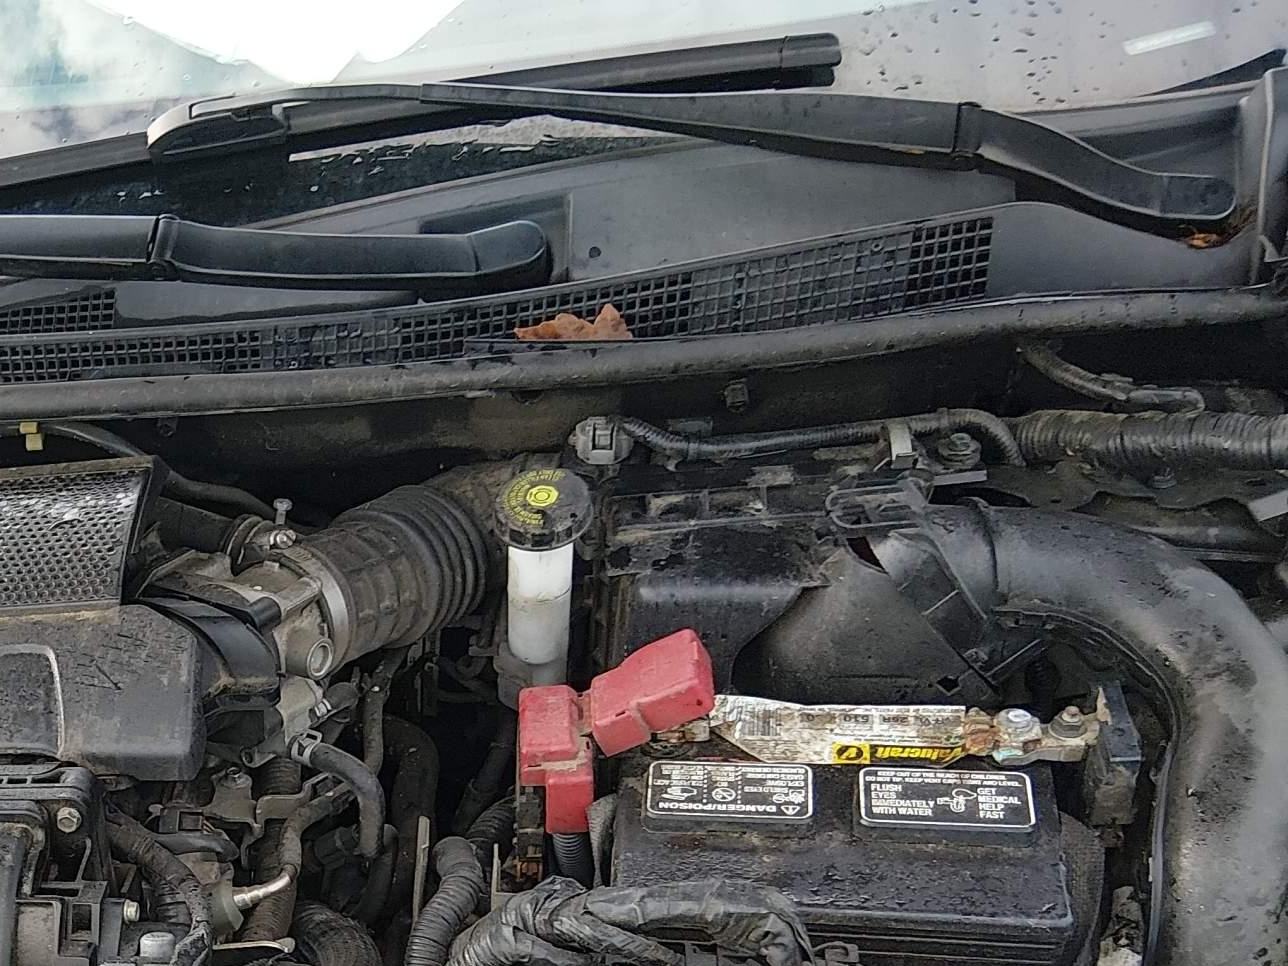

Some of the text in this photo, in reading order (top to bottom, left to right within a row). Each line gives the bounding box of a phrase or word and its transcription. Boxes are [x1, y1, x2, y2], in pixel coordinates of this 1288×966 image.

[874, 745, 962, 762] Valucraft
[871, 783, 902, 791] FLUSH
[977, 787, 997, 795] GET
[871, 791, 897, 799] EYES
[978, 795, 1022, 804] MEDICAL
[658, 802, 777, 812] DANGER/POISON
[871, 798, 935, 808] IMMEDIATELY
[978, 802, 1005, 811] HELP
[872, 806, 933, 816] WITH WATER
[979, 810, 1005, 819] FAST
